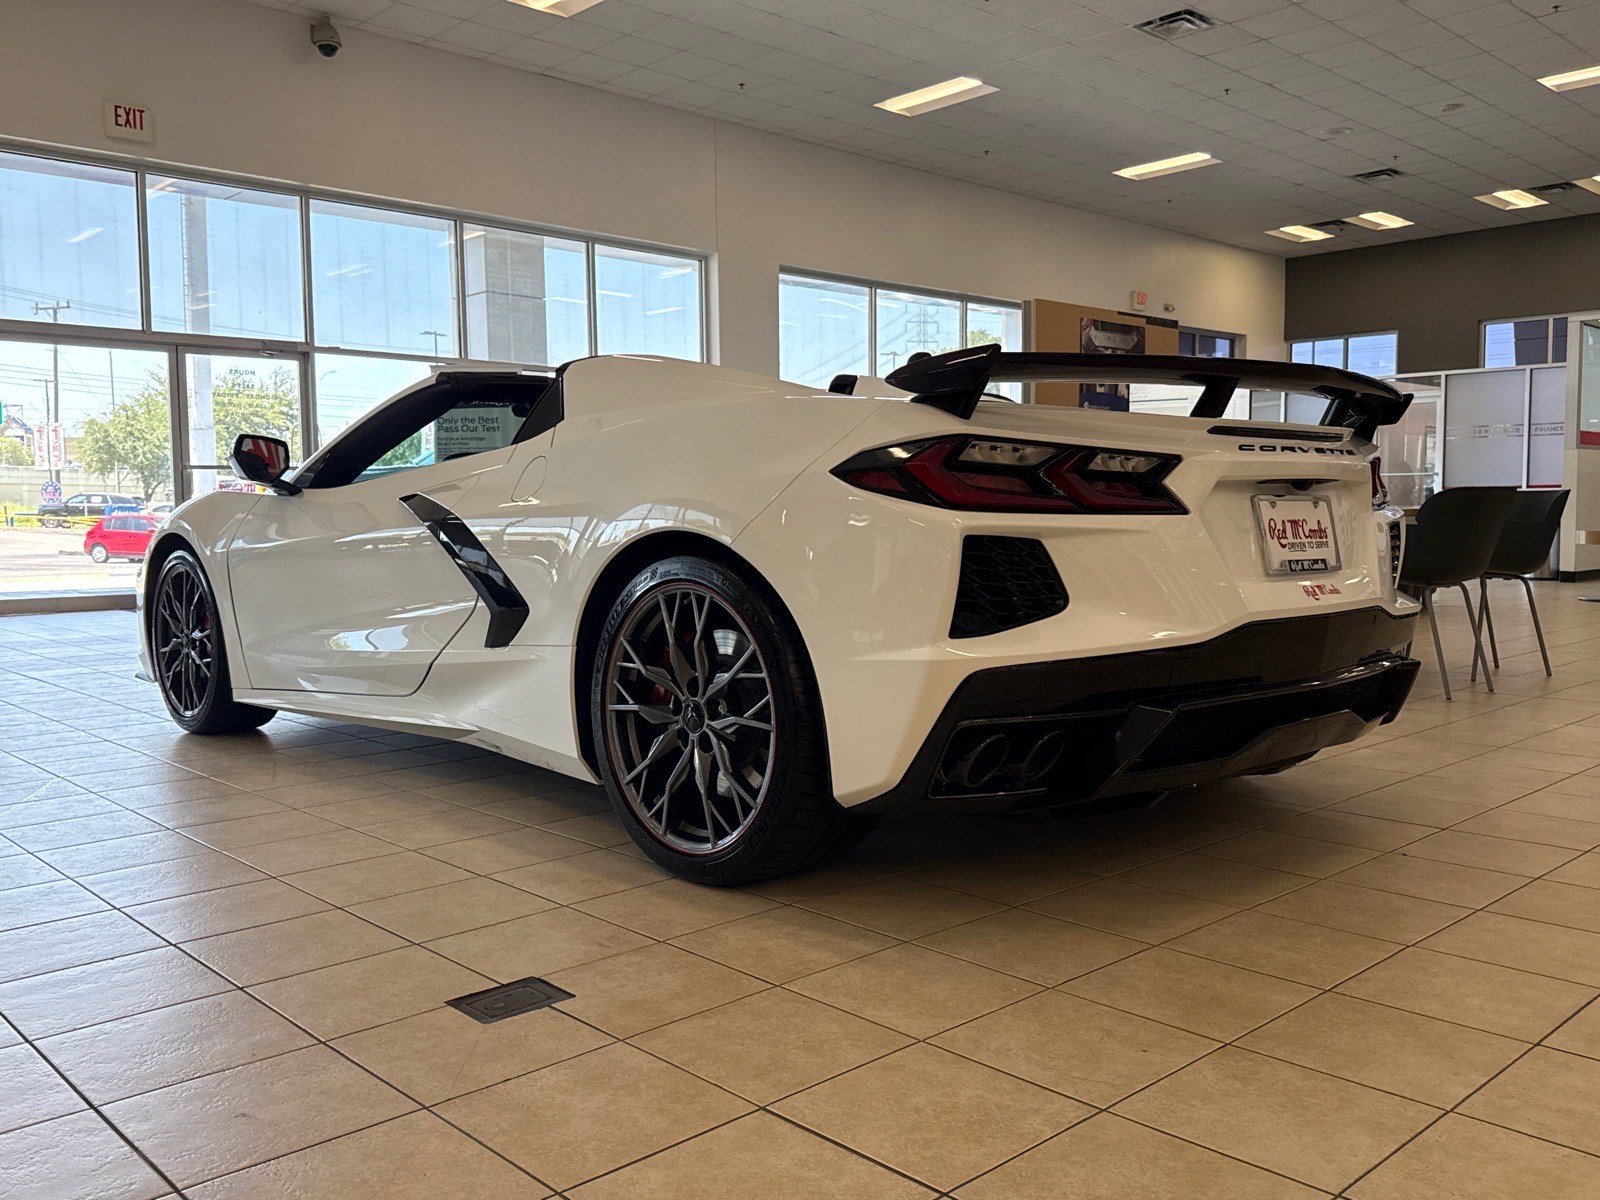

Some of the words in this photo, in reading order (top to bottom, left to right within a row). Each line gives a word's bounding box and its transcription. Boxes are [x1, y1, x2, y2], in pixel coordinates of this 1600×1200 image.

[114, 104, 145, 131] EXIT
[437, 416, 459, 425] Only
[460, 416, 476, 424] the
[478, 416, 499, 424] Best
[437, 425, 460, 433] Pass
[480, 424, 501, 432] Test
[1238, 444, 1356, 456] CORVETTE
[1268, 517, 1289, 549] Red
[1287, 518, 1328, 540] McCombs
[1287, 541, 1307, 550] DRIVEN
[1307, 541, 1315, 549] TO
[1314, 540, 1329, 549] SERVE
[1302, 585, 1320, 601] Red
